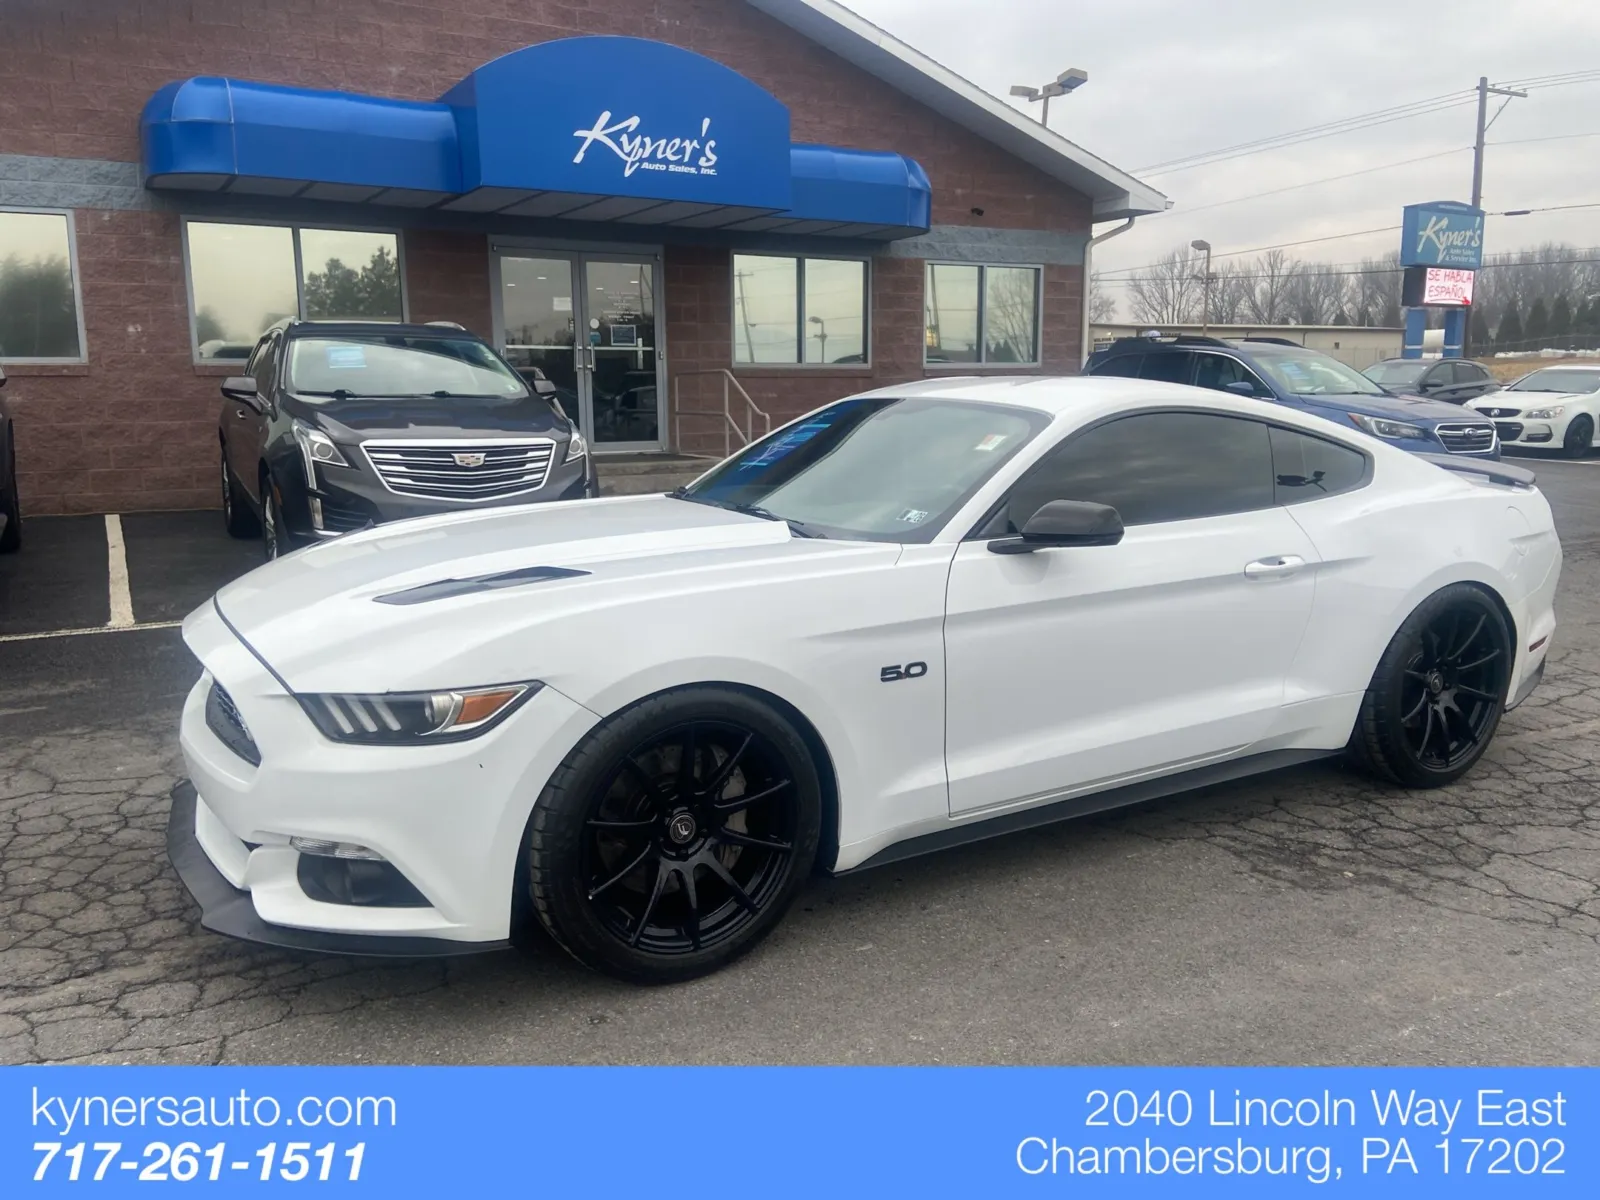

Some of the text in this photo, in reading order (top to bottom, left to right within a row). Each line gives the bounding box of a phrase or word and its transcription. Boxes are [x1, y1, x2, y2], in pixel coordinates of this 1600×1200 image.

[573, 110, 718, 178] Kyner's
[641, 161, 718, 176] Auto Sales, Inc.
[1417, 215, 1481, 264] Kyner's
[1428, 269, 1473, 284] SE HABLA
[1428, 284, 1467, 298] ESPAÑOL
